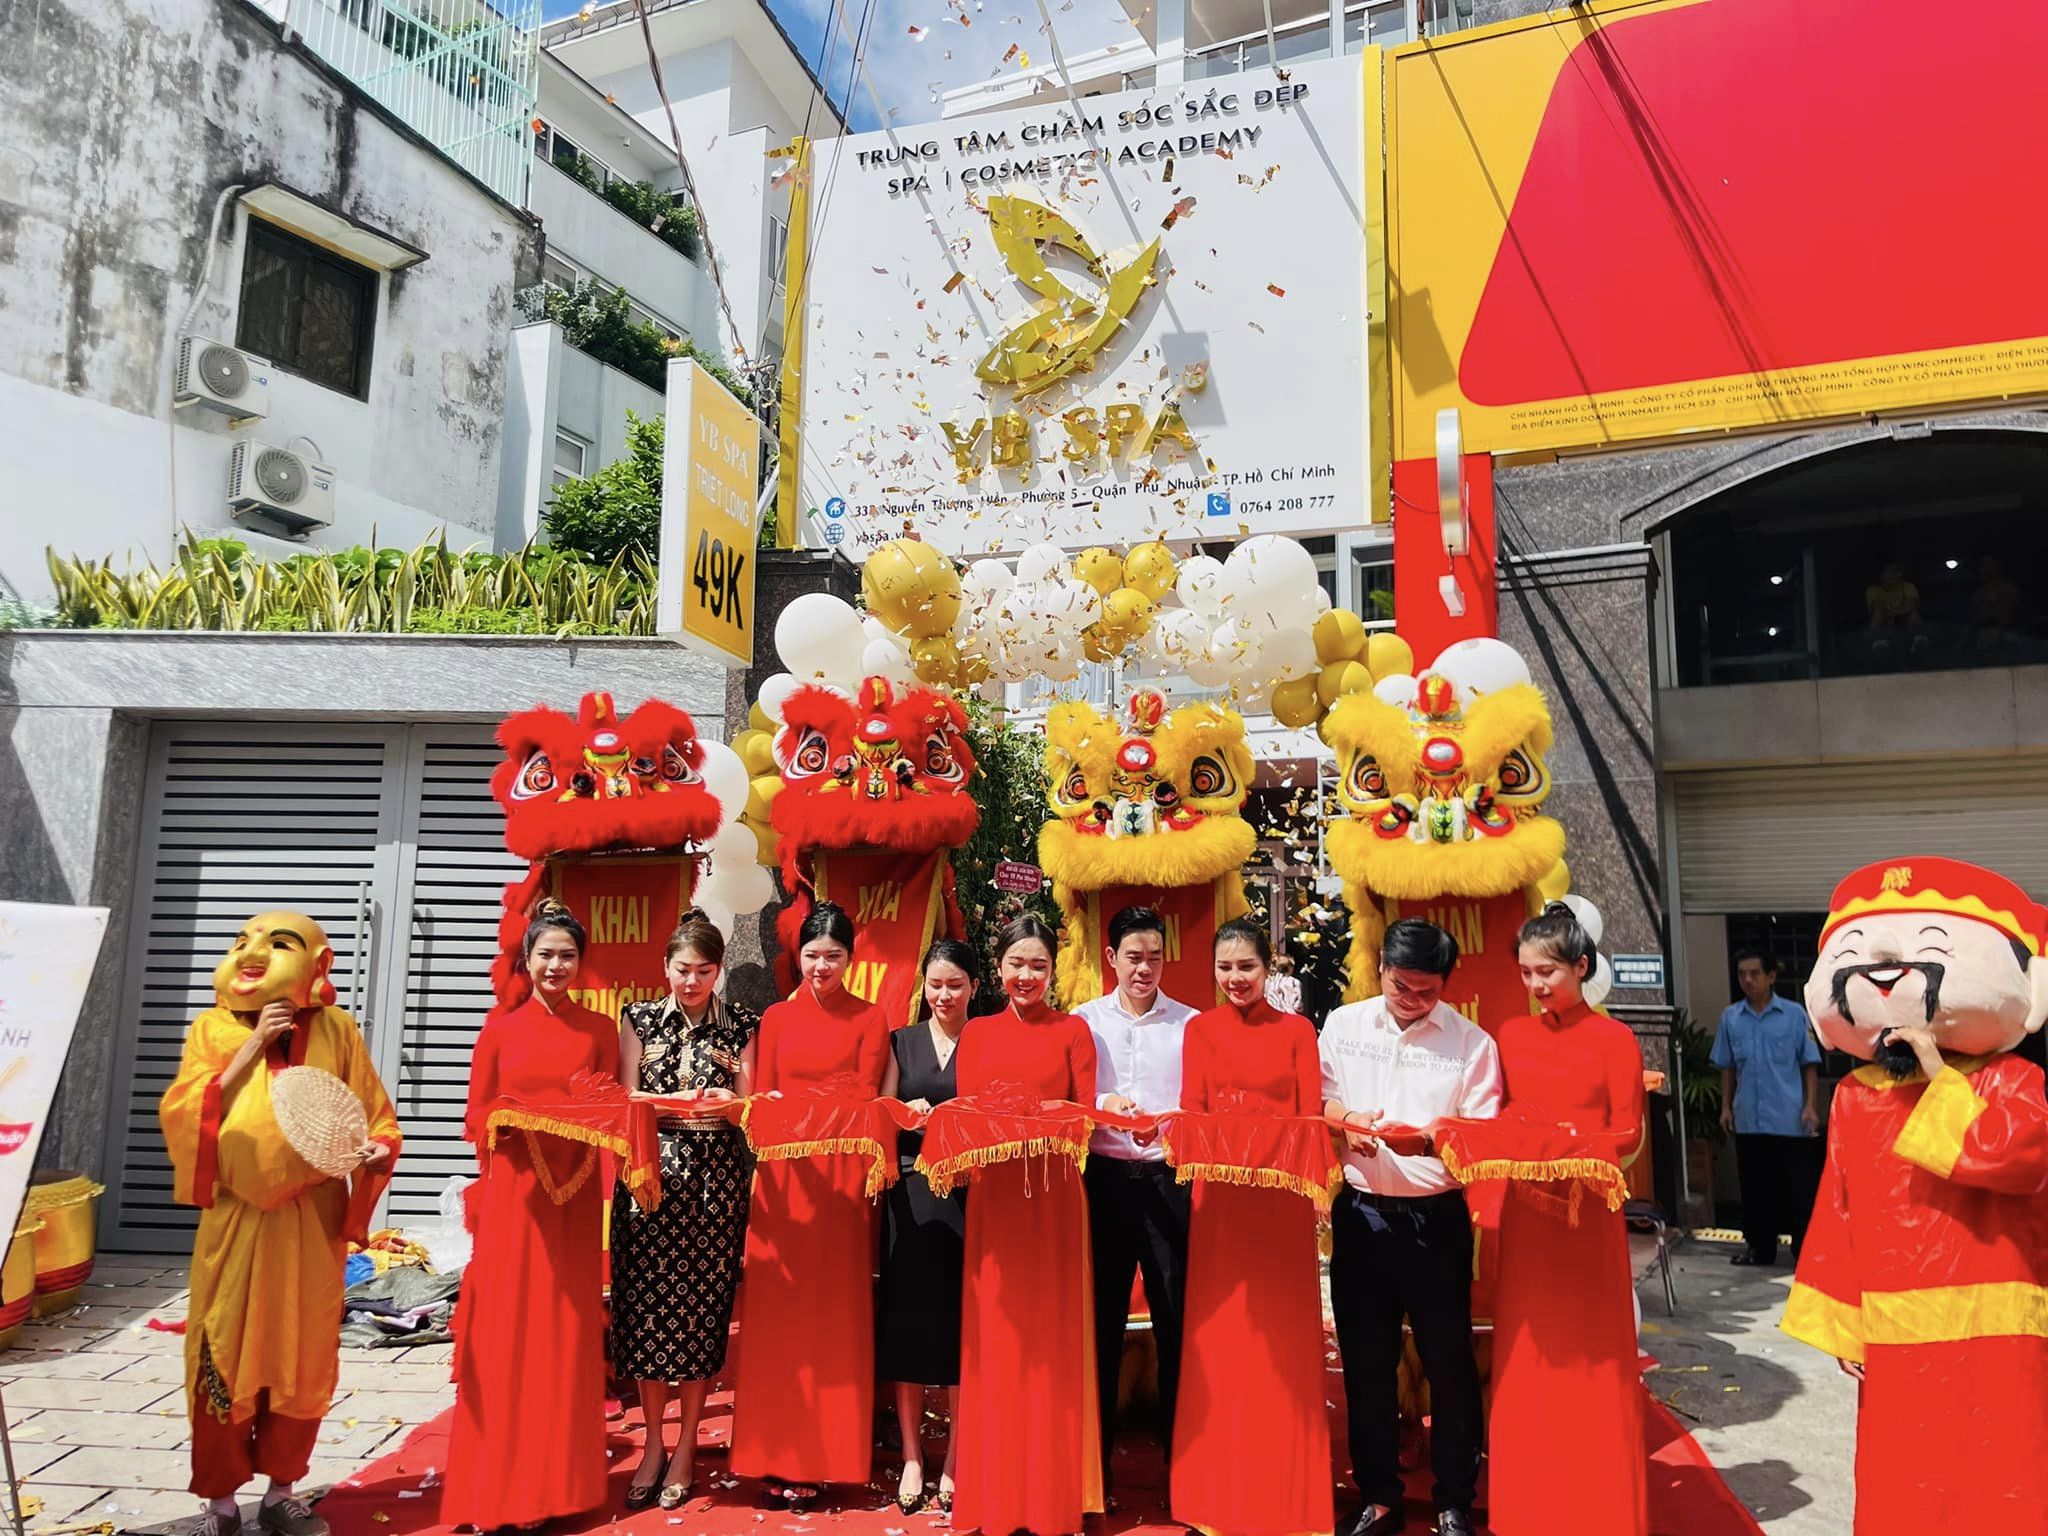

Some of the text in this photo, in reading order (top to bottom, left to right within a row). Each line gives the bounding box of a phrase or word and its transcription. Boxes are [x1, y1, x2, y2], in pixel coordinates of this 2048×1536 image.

[856, 141, 939, 166] TRUNG
[954, 130, 1008, 151] TÂM
[1118, 100, 1171, 127] SÓC
[1185, 88, 1237, 116] SẮC
[1254, 83, 1307, 108] ĐẸP
[888, 176, 930, 194] SPA
[1118, 125, 1260, 161] ACADEMY
[699, 413, 748, 479] YB SPA
[939, 400, 1199, 471] YB SPA
[1071, 488, 1078, 499] 5
[1092, 484, 1127, 499] Quận
[1167, 476, 1212, 491] Nhuậ
[1271, 466, 1295, 481] Chí
[1301, 464, 1335, 478] Minh
[1240, 495, 1335, 513] 0764 208 777
[693, 528, 745, 630] 49K
[590, 896, 649, 944] KHAI
